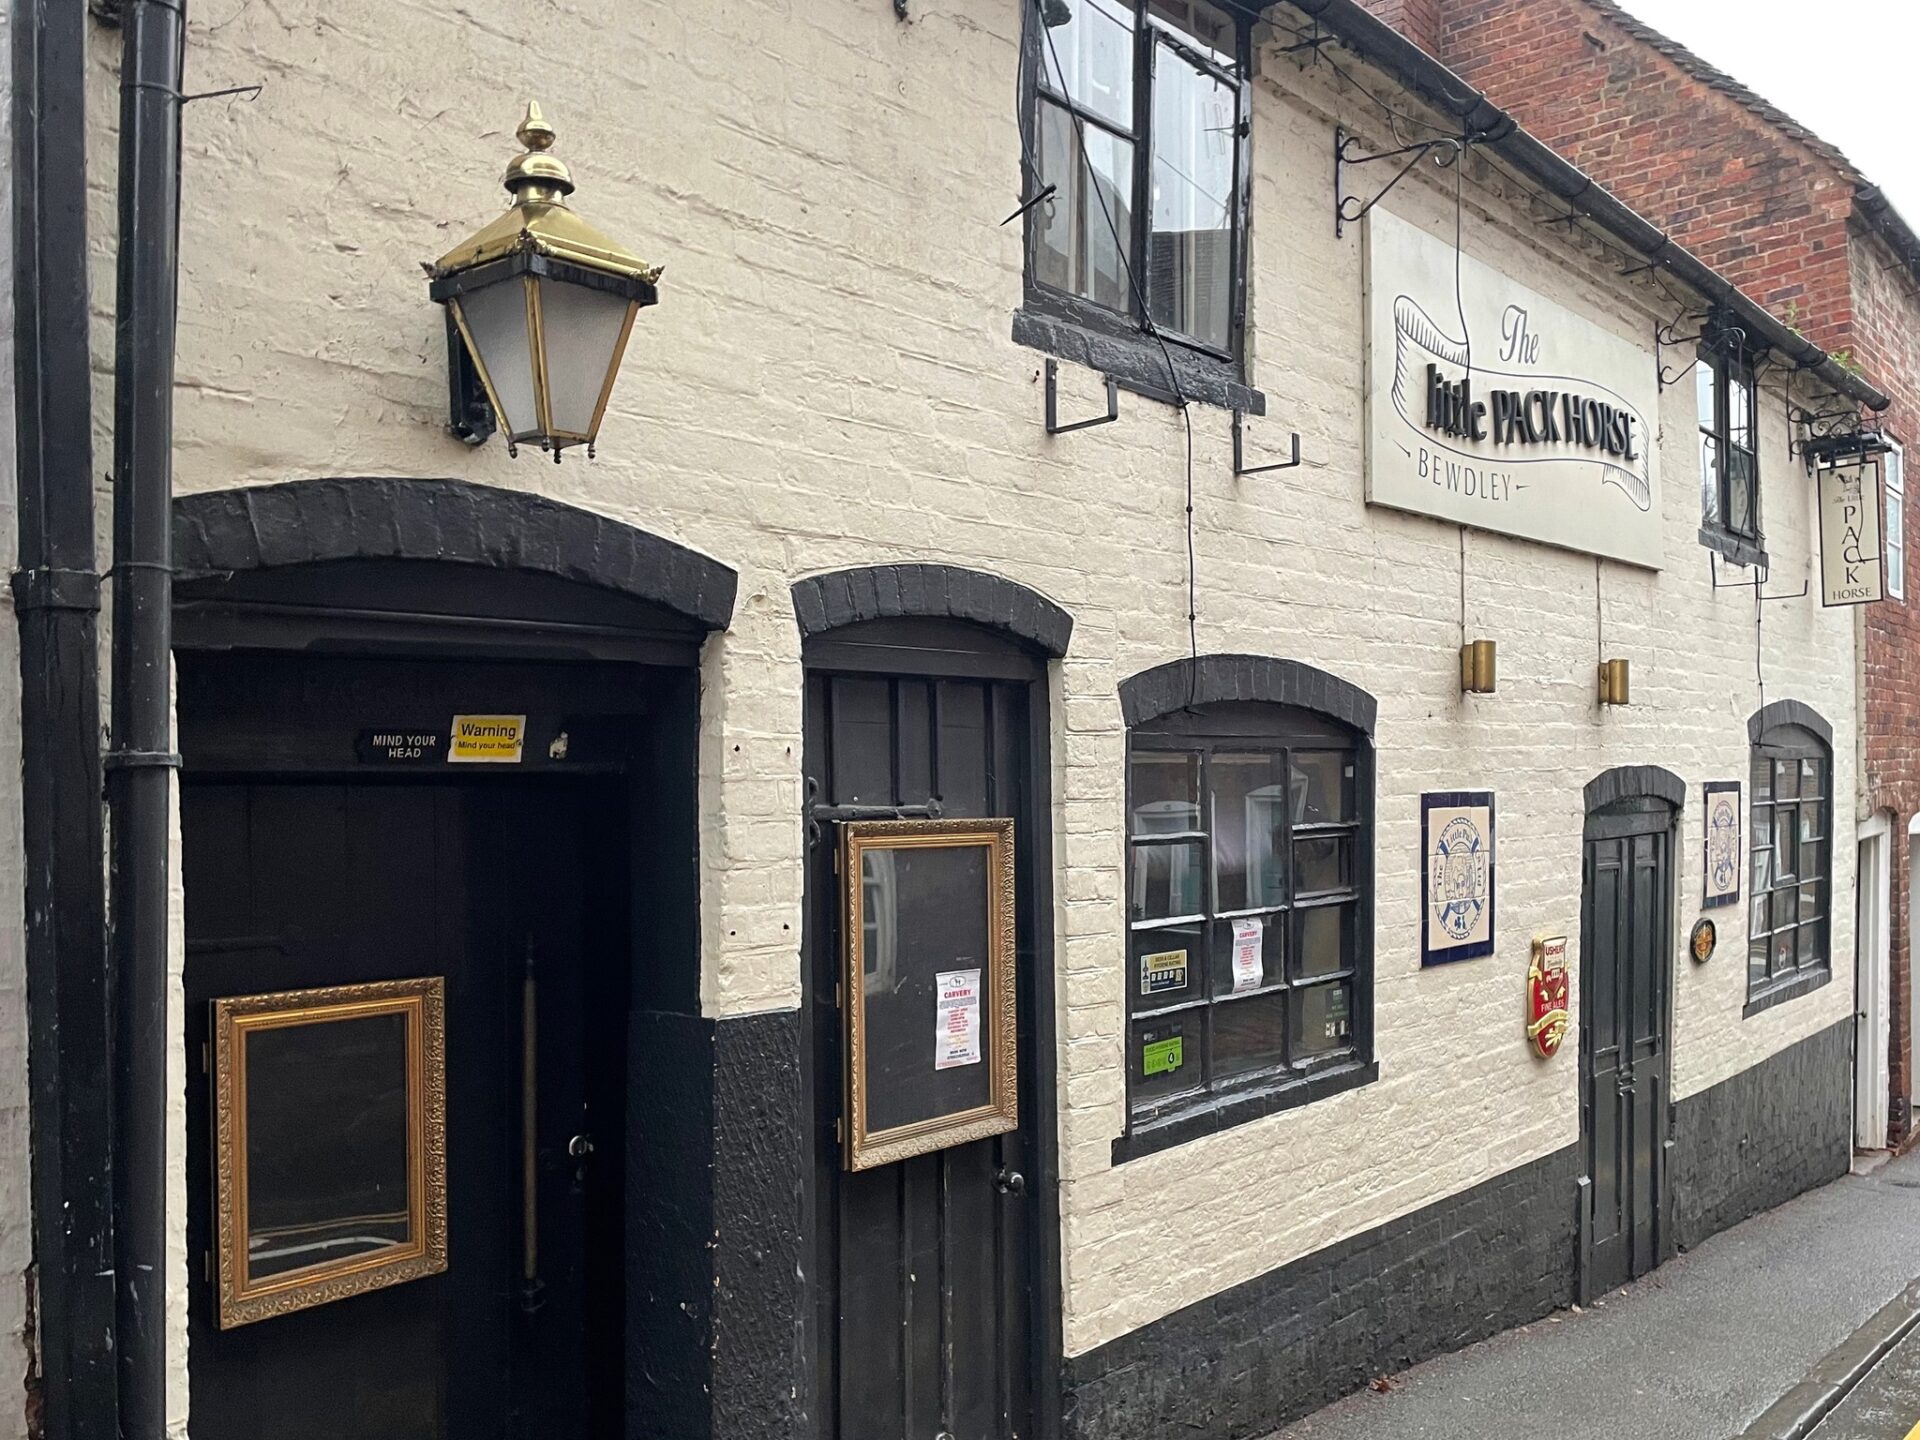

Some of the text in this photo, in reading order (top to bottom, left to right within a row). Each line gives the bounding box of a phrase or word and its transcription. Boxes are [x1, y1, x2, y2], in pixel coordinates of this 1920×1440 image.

[1499, 304, 1540, 365] The
[1425, 362, 1639, 462] little PACK HORSE
[1417, 446, 1512, 502] BEWDLEY
[1841, 505, 1860, 585] PACK
[1832, 587, 1873, 601] HORSE
[460, 723, 517, 740] Warning
[372, 735, 437, 747] MIND YOUR
[457, 740, 516, 751] Mind your head
[387, 748, 422, 758] HEAD
[1545, 944, 1565, 957] USHERS
[943, 989, 972, 999] CARVERY
[1541, 999, 1565, 1013] FINE ALES
